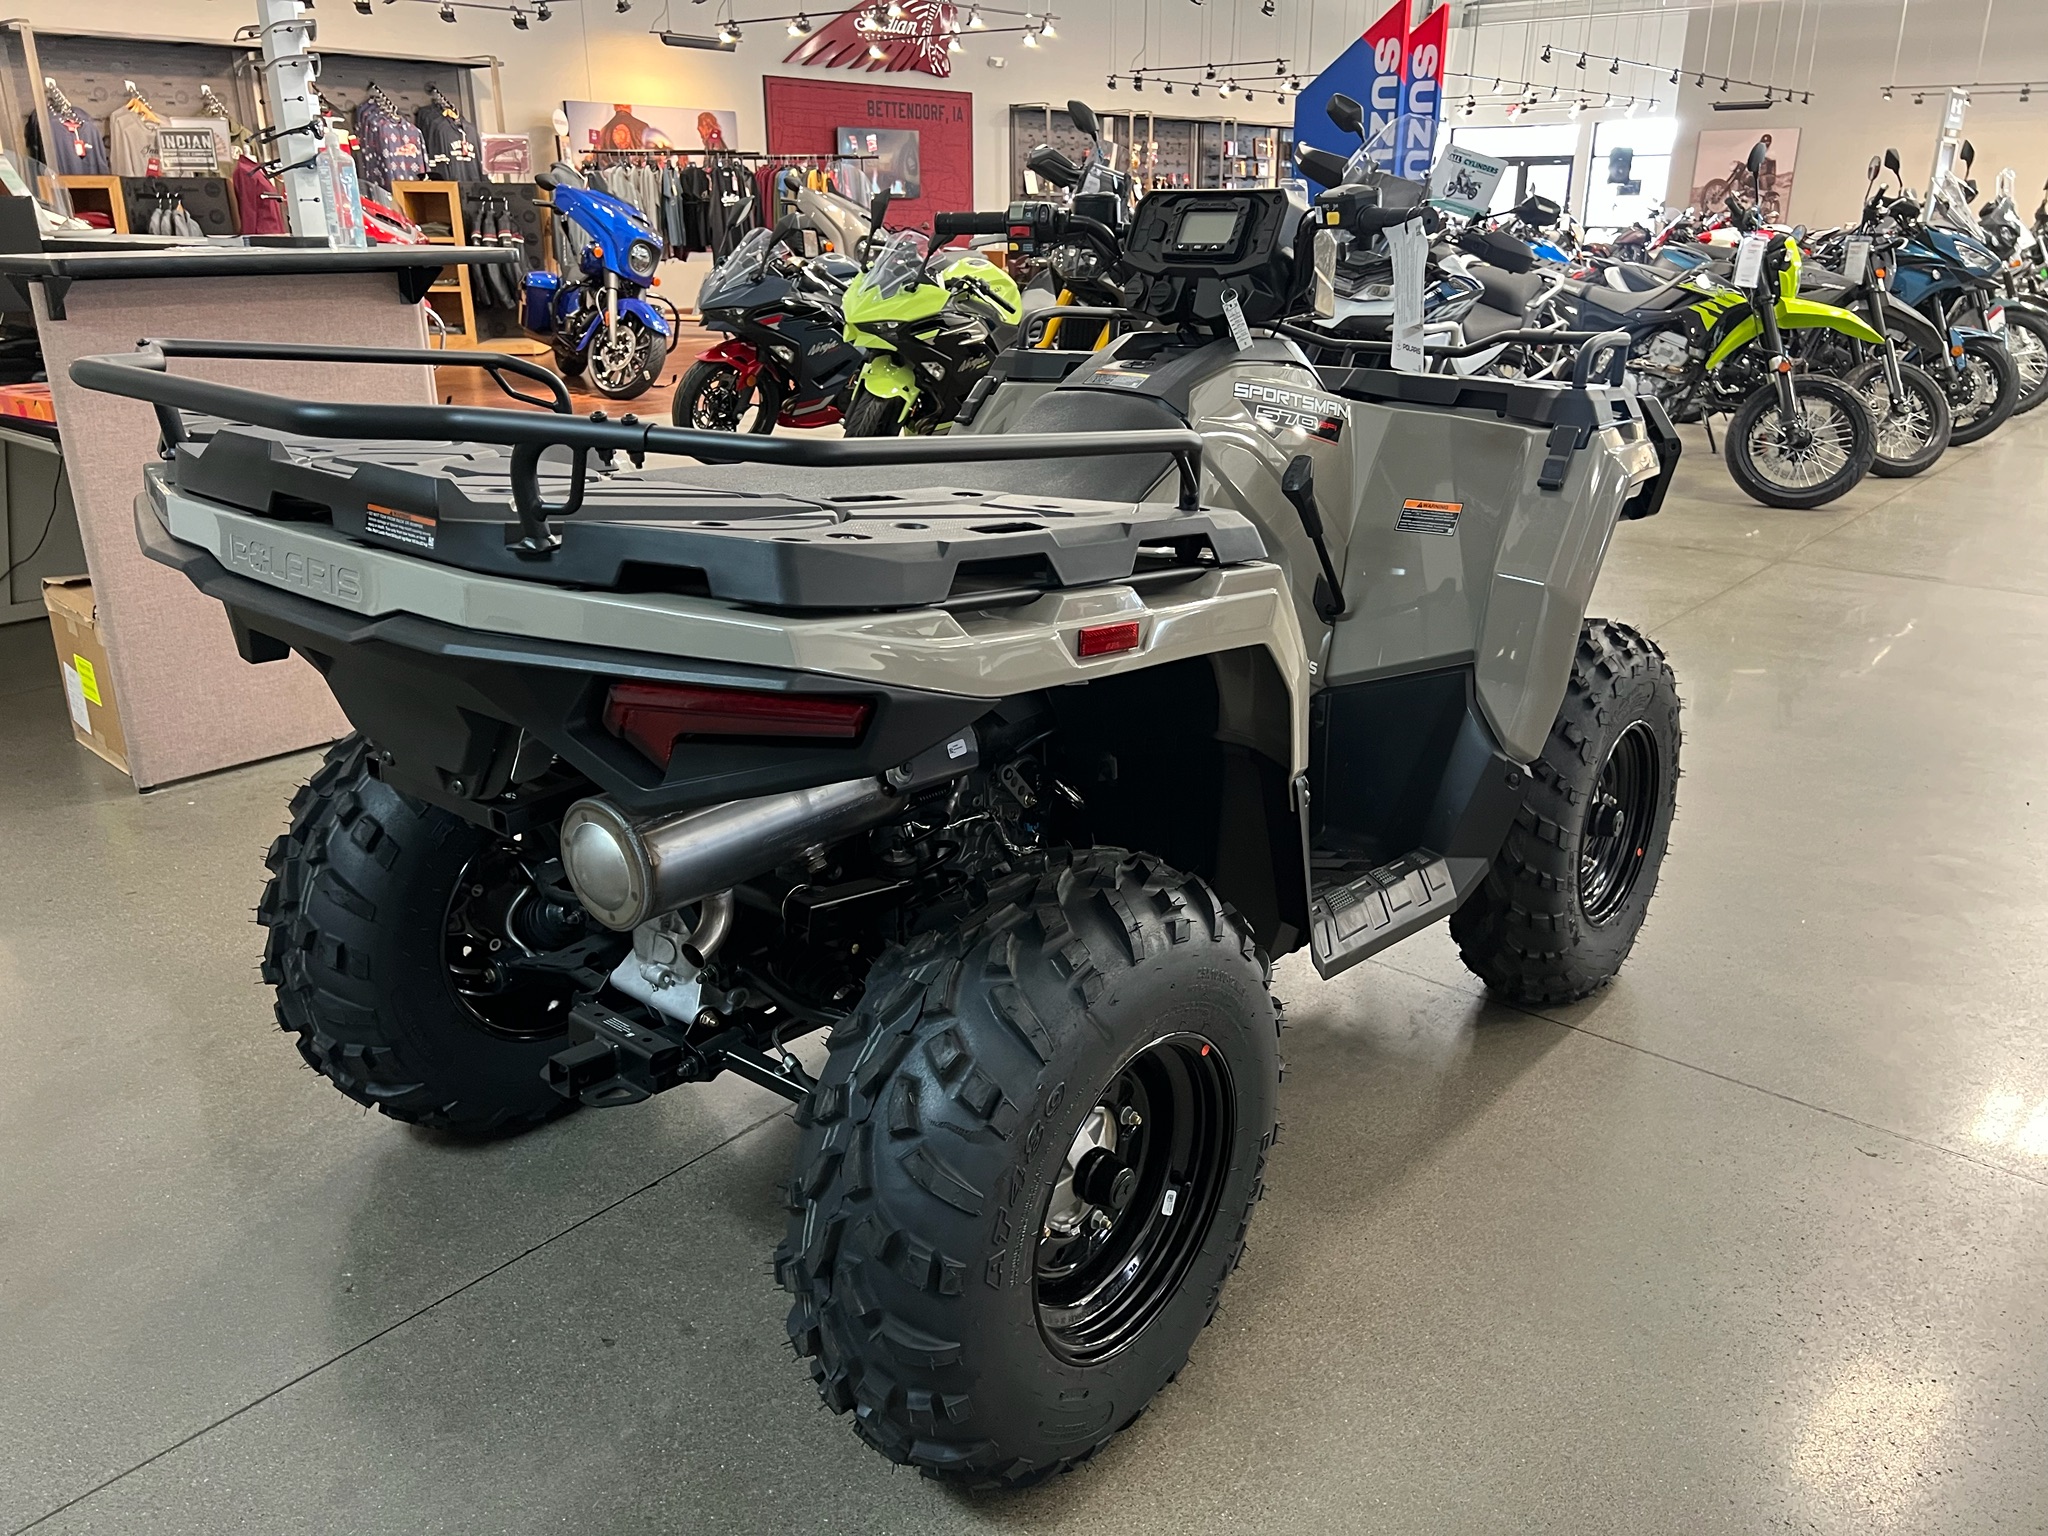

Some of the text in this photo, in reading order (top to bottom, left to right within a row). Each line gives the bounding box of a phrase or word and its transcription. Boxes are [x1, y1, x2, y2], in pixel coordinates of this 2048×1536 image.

[952, 106, 964, 122] IA
[1369, 37, 1400, 174] SUZU
[1404, 44, 1438, 183] SUZU
[160, 134, 212, 149] INDIAN
[1463, 158, 1499, 174] CYLINDERS
[1402, 343, 1421, 355] POLARIS
[1233, 382, 1349, 421] SPORTSMAN
[1255, 404, 1319, 431] 570
[1422, 502, 1449, 511] WARNING
[229, 533, 363, 604] POLARIS
